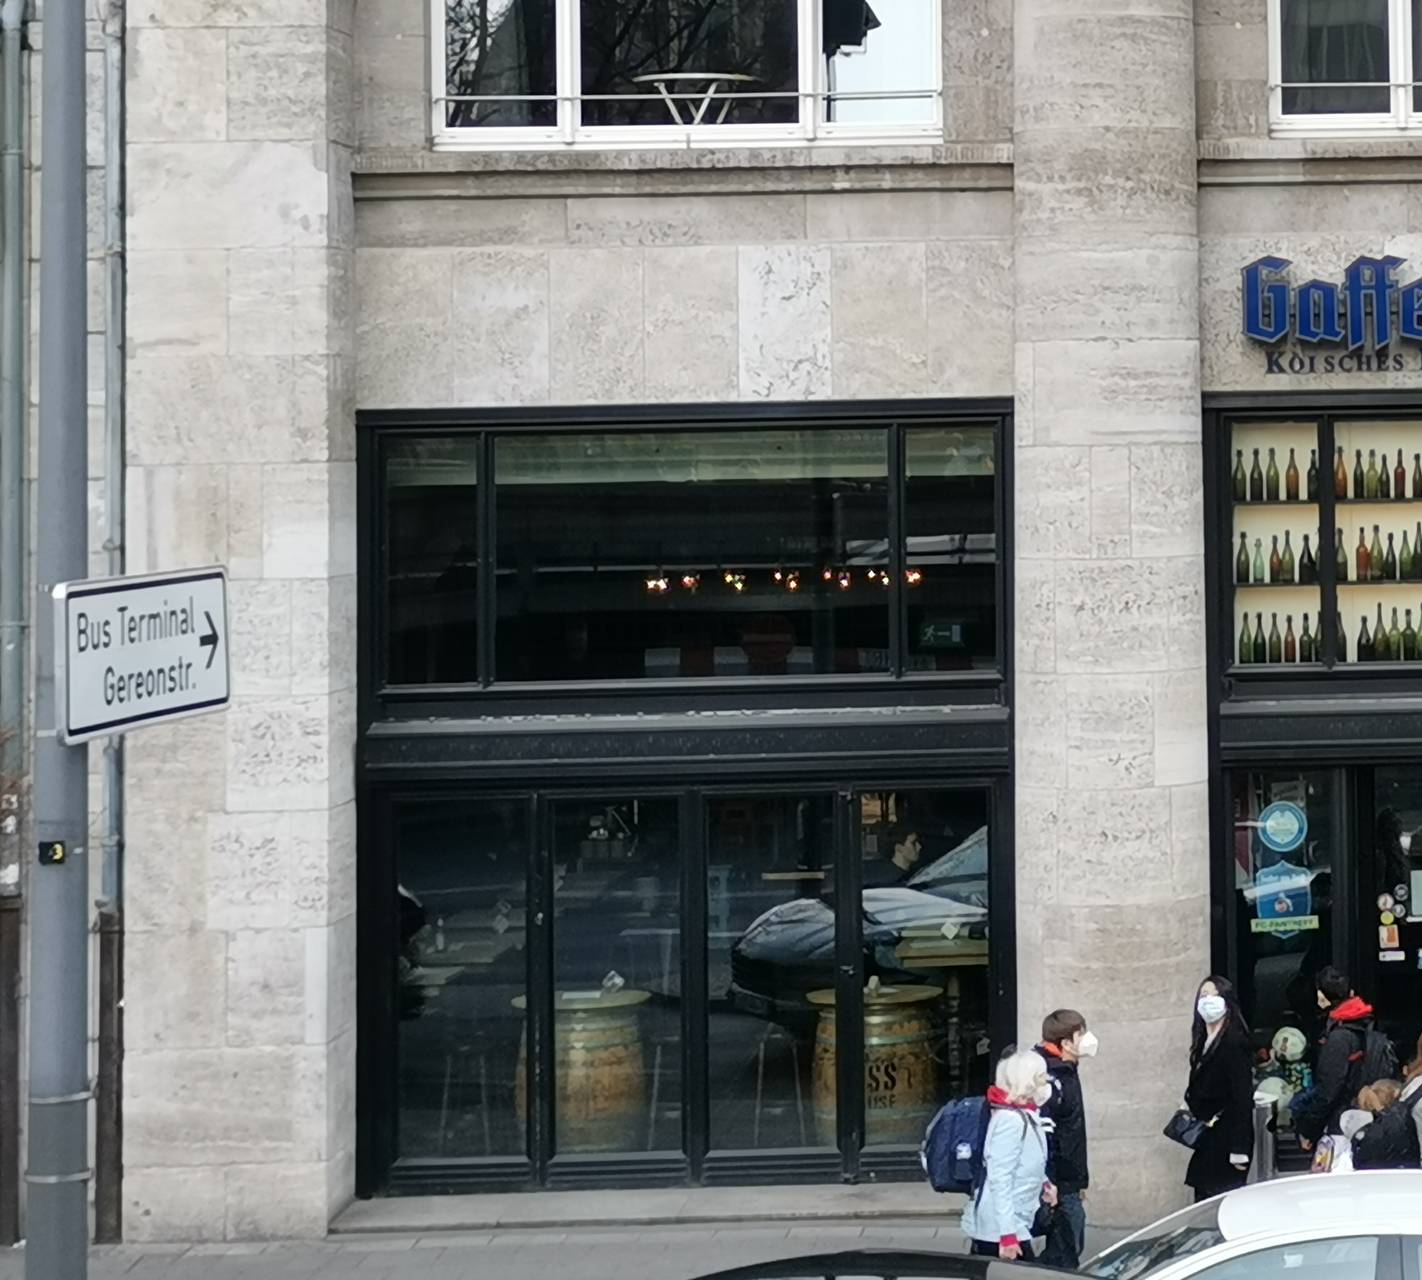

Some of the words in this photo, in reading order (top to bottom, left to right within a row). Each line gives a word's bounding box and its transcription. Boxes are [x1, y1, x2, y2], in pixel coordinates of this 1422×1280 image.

[77, 612, 112, 653] Bus
[117, 595, 196, 647] Terminal
[103, 656, 197, 706] Gereonstr.
